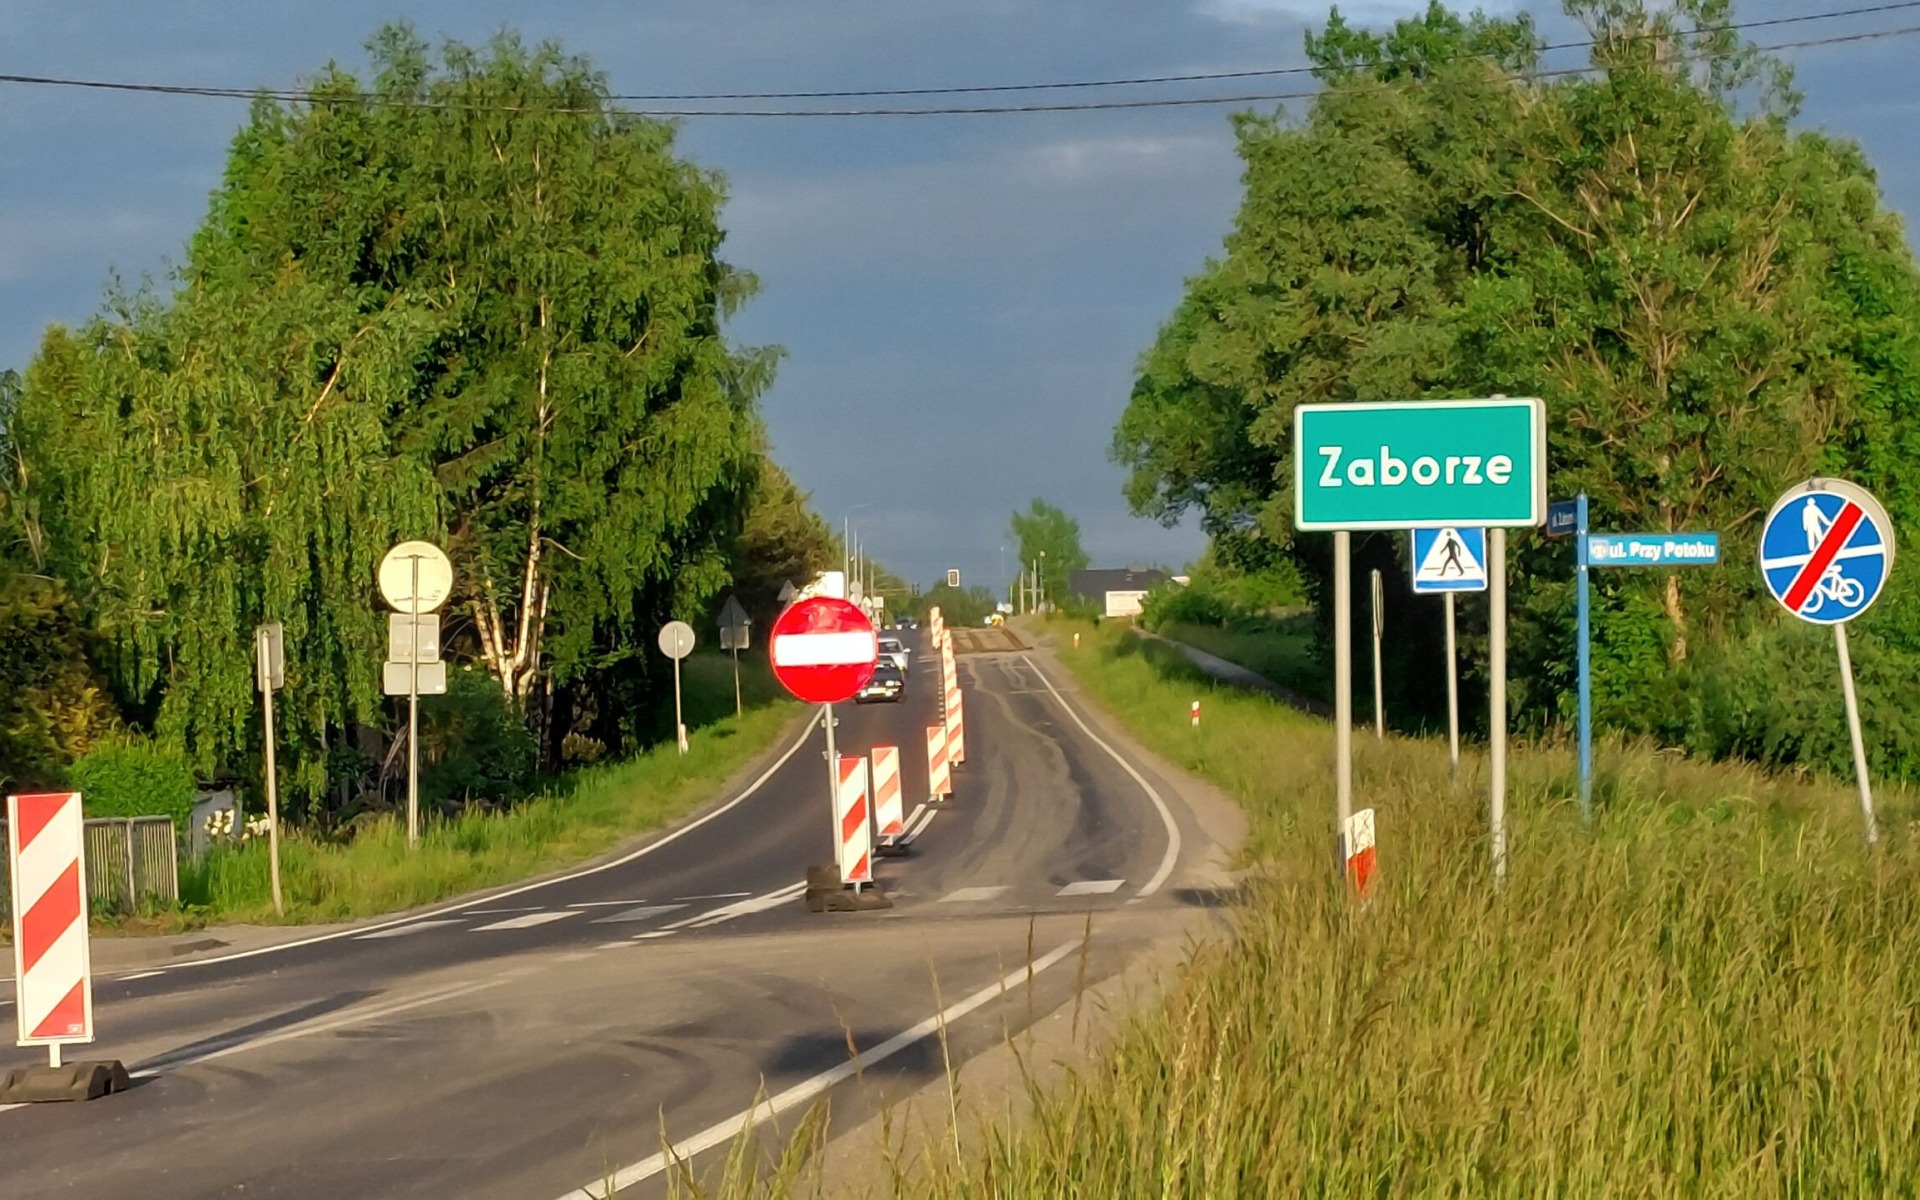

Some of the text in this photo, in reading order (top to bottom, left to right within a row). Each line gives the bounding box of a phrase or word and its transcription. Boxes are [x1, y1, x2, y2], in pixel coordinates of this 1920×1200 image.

[1318, 445, 1513, 488] Zaborze
[1609, 541, 1716, 561] ul. Przy Potoku
